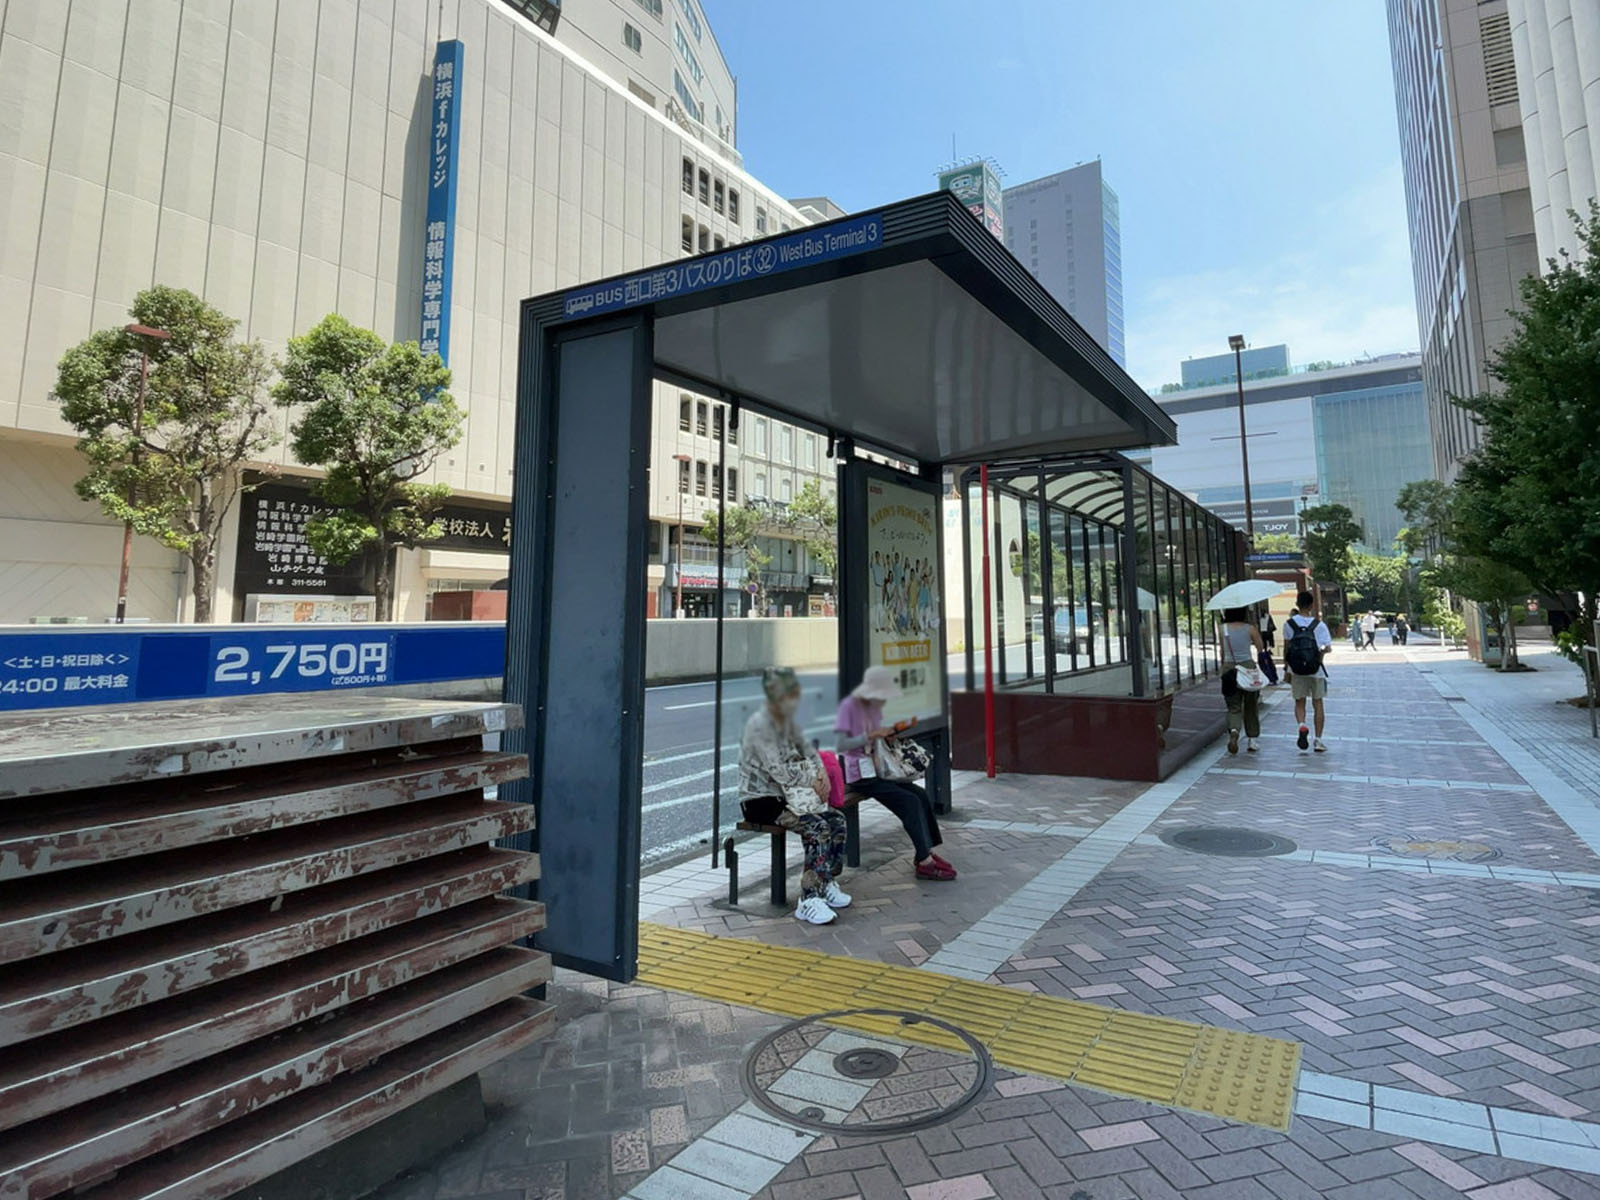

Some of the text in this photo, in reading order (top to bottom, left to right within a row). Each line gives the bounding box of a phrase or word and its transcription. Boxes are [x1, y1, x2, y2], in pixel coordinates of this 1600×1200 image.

[595, 287, 623, 307] BUS
[779, 243, 804, 263] West
[804, 239, 823, 257] Bus
[824, 225, 867, 252] Terminal
[868, 222, 878, 241] 3
[0, 674, 129, 694] 4:00 最大料金
[214, 642, 388, 685] 2,750円
